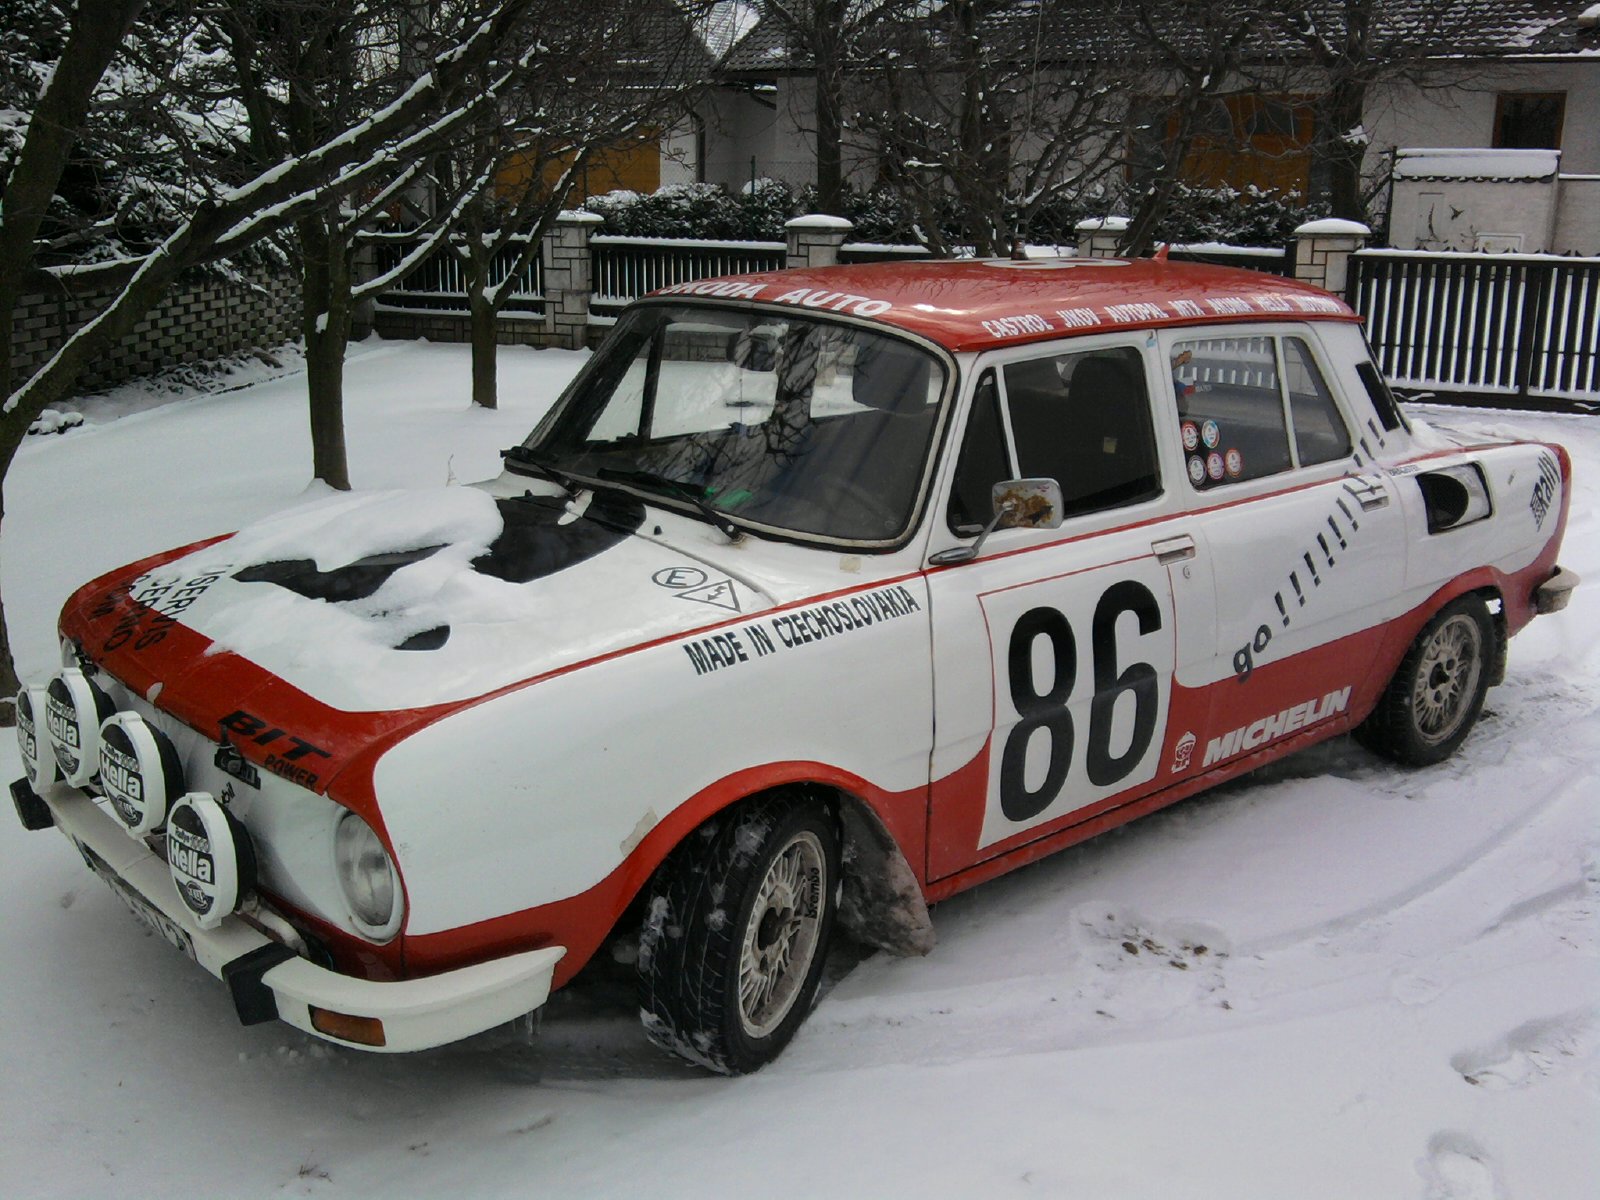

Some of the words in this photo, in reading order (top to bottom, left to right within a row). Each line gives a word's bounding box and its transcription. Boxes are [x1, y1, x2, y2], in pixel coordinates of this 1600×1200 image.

[773, 288, 892, 317] AUTO
[982, 313, 1054, 338] CASTROL
[1104, 302, 1169, 323] AUTOPAL
[1534, 451, 1561, 512] Rally
[683, 631, 749, 676] MADE
[743, 623, 776, 657] IN
[771, 585, 921, 649] CZECHOSLOVAKIA
[999, 579, 1162, 823] 86
[218, 710, 332, 760] BIT
[1201, 686, 1352, 768] MICHELIN
[101, 752, 141, 801] Hella
[264, 754, 320, 795] POWER
[170, 837, 212, 883] Hella
